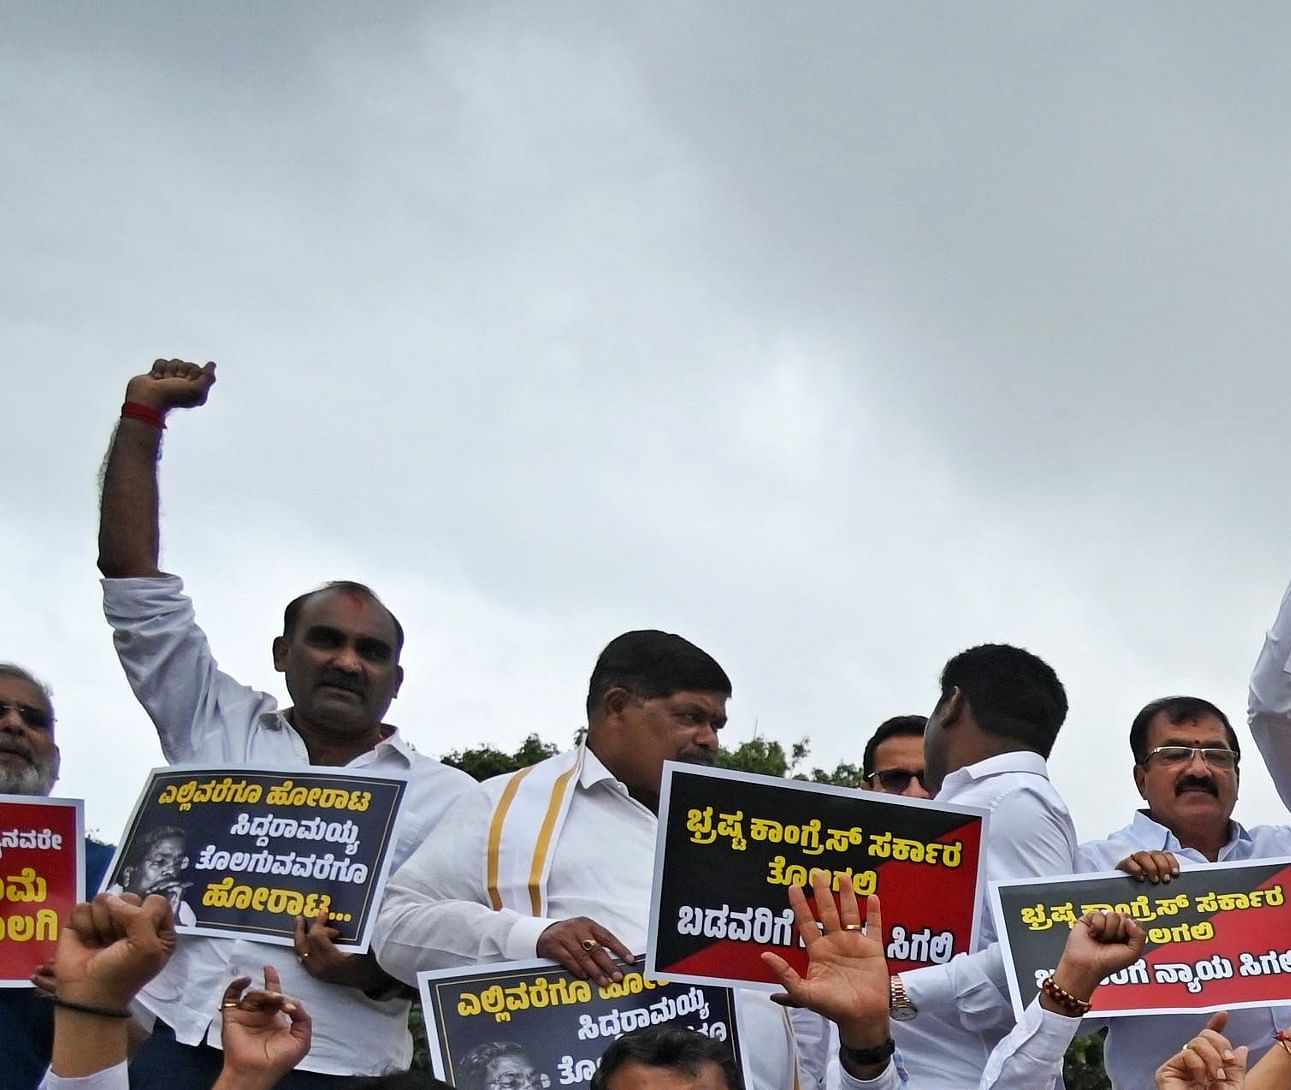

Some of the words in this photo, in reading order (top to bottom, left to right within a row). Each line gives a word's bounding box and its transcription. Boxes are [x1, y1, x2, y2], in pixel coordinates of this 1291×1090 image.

[158, 777, 262, 811] ಎಲ್ಲಿವರೆಗೂ
[266, 781, 371, 811] ಹೋರಾಟ
[231, 813, 360, 854] ಸಿದ್ದರಾಮಯ್ಯ
[686, 806, 747, 851] ಭ್ರಷ್ಟ
[750, 819, 862, 856] ಕಾಂಗ್ರೆಸ್
[868, 831, 962, 868] ಸರ್ಕಾರ
[195, 845, 368, 884] ತೊಲಗುವವರೆಗೂ
[1195, 885, 1284, 913] ಸರ್ಕಾರ
[677, 904, 794, 947] ಬಡವರಿಗೆ
[887, 926, 954, 964] ಸಿಗಲಿ
[1154, 953, 1232, 993] ನ್ಯಾಯ
[457, 977, 591, 1023] ಎಲ್ಲಿವರೆಗೂ
